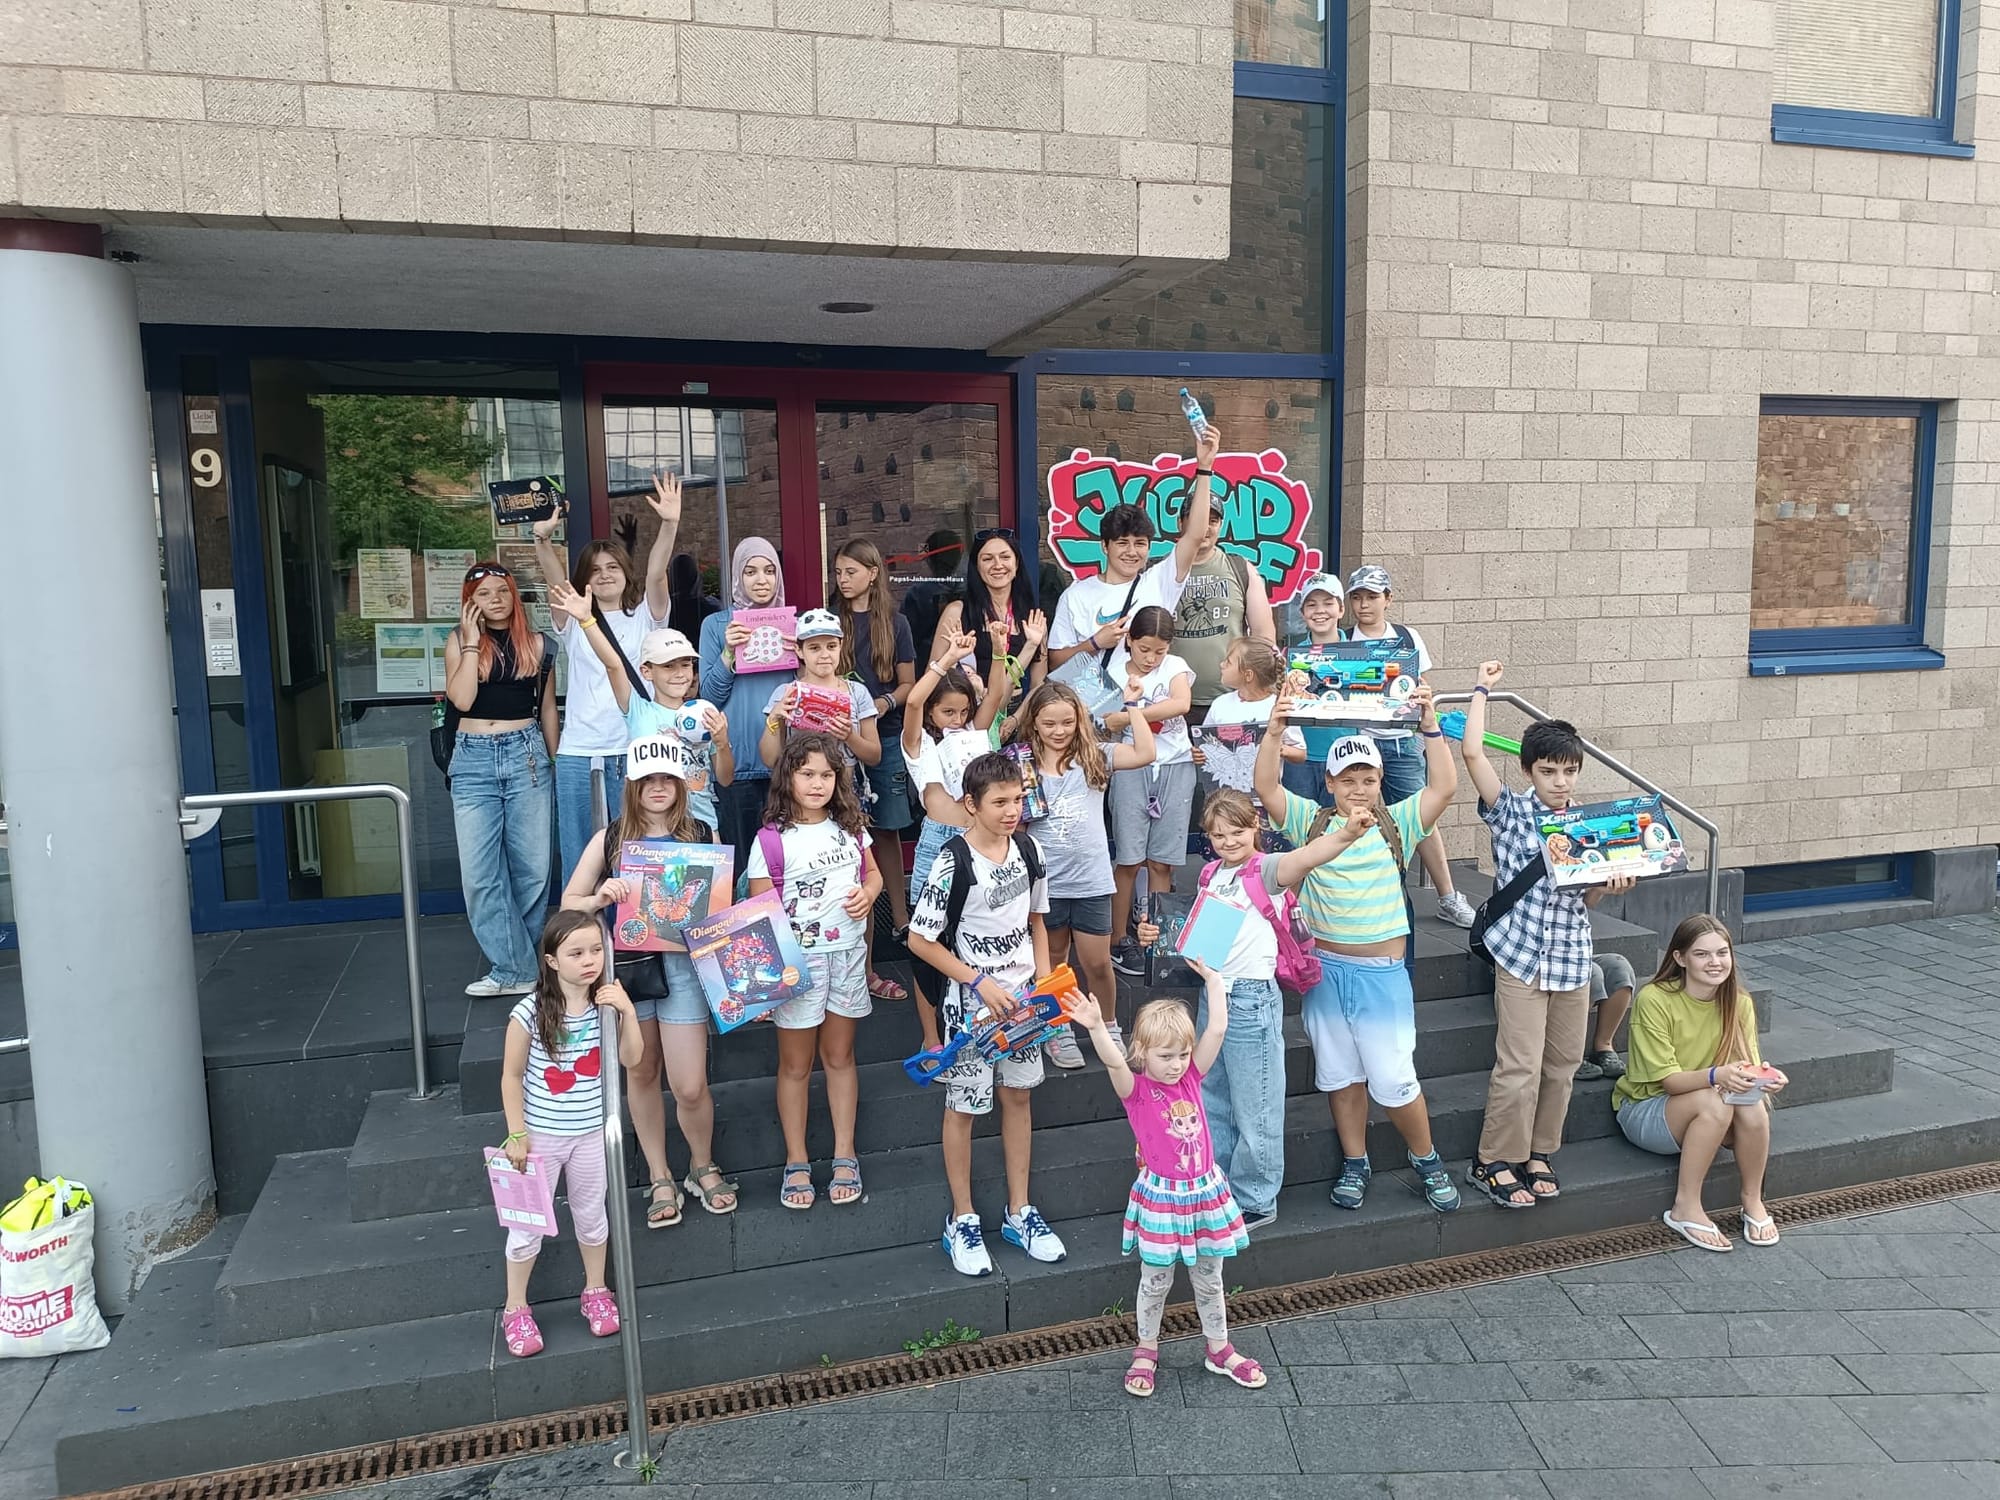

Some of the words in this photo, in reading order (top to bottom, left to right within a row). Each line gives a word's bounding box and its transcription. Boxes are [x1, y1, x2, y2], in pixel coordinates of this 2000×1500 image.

[191, 448, 222, 488] 9
[1075, 467, 1293, 541] JUGND
[628, 844, 680, 862] Diamond
[809, 850, 859, 870] UNIQUE
[690, 913, 735, 939] Diamond
